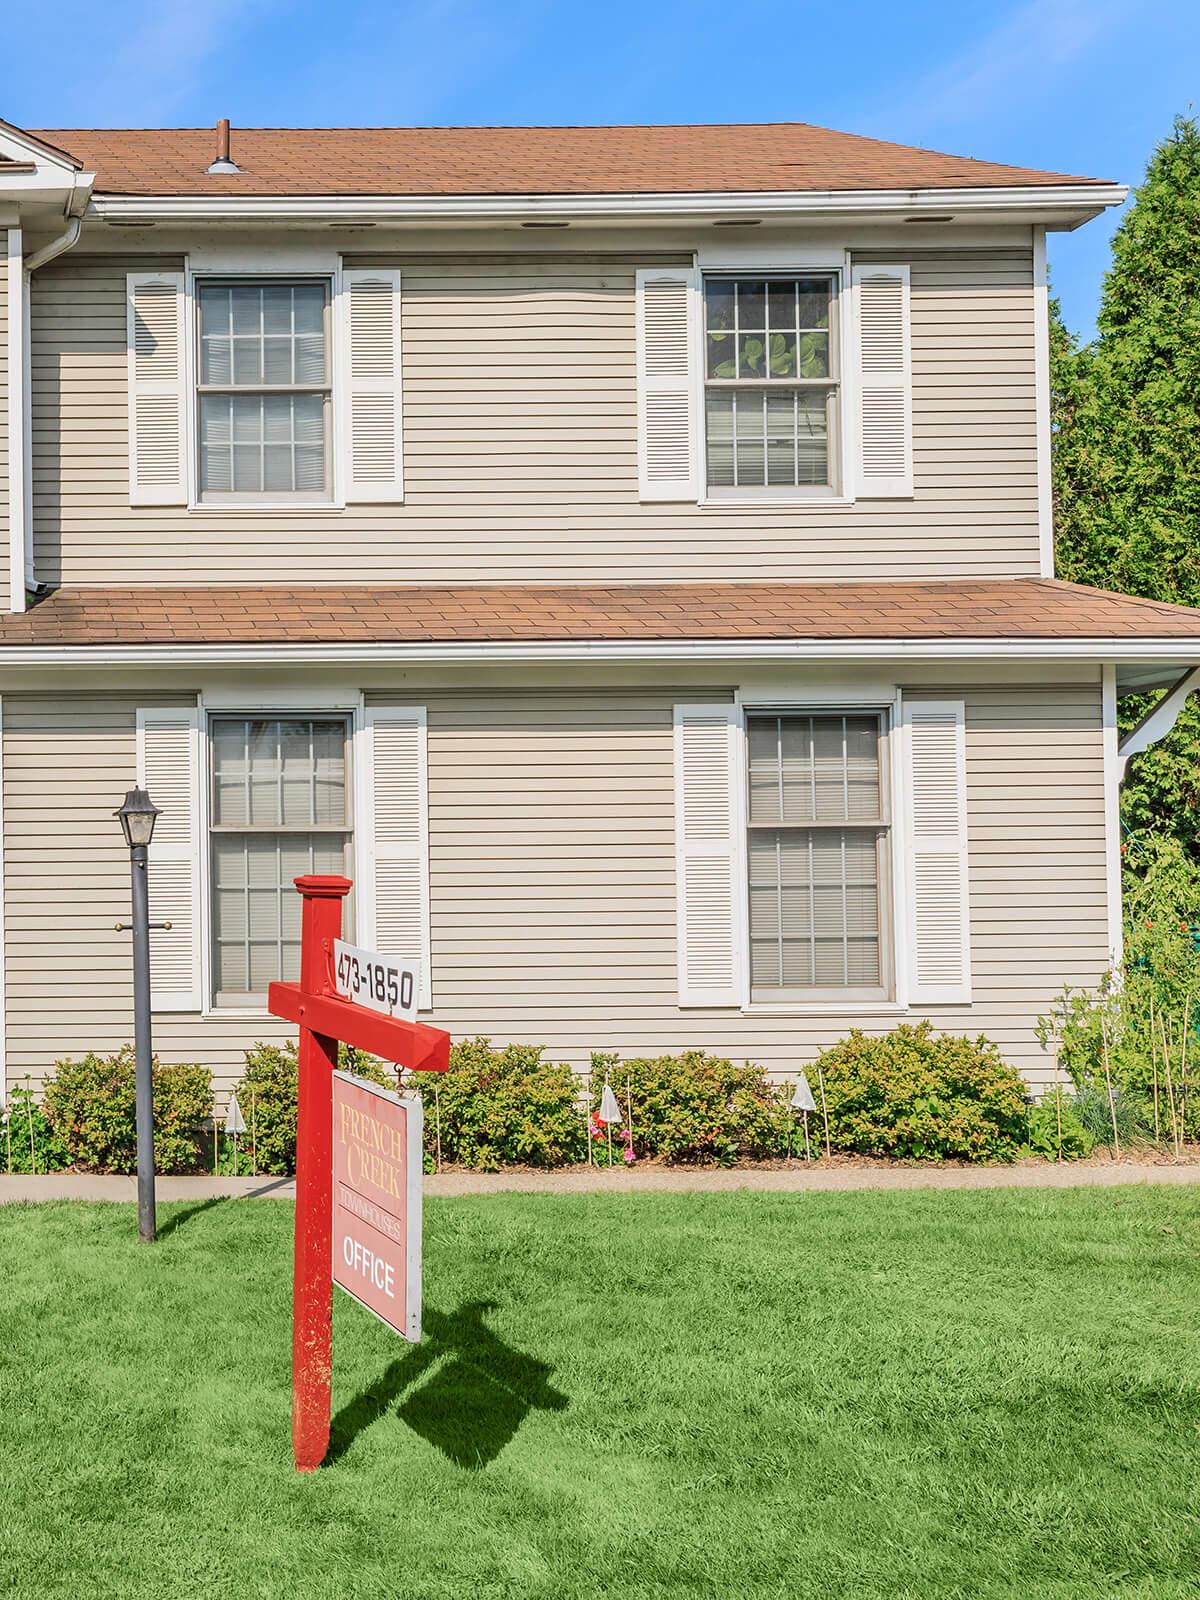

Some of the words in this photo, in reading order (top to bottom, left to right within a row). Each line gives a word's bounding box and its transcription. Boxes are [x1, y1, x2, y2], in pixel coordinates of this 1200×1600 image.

[338, 951, 414, 1010] 473-1850
[338, 1102, 402, 1163] FRENCH
[347, 1142, 401, 1200] CREEK
[343, 1235, 395, 1299] OFFICE
